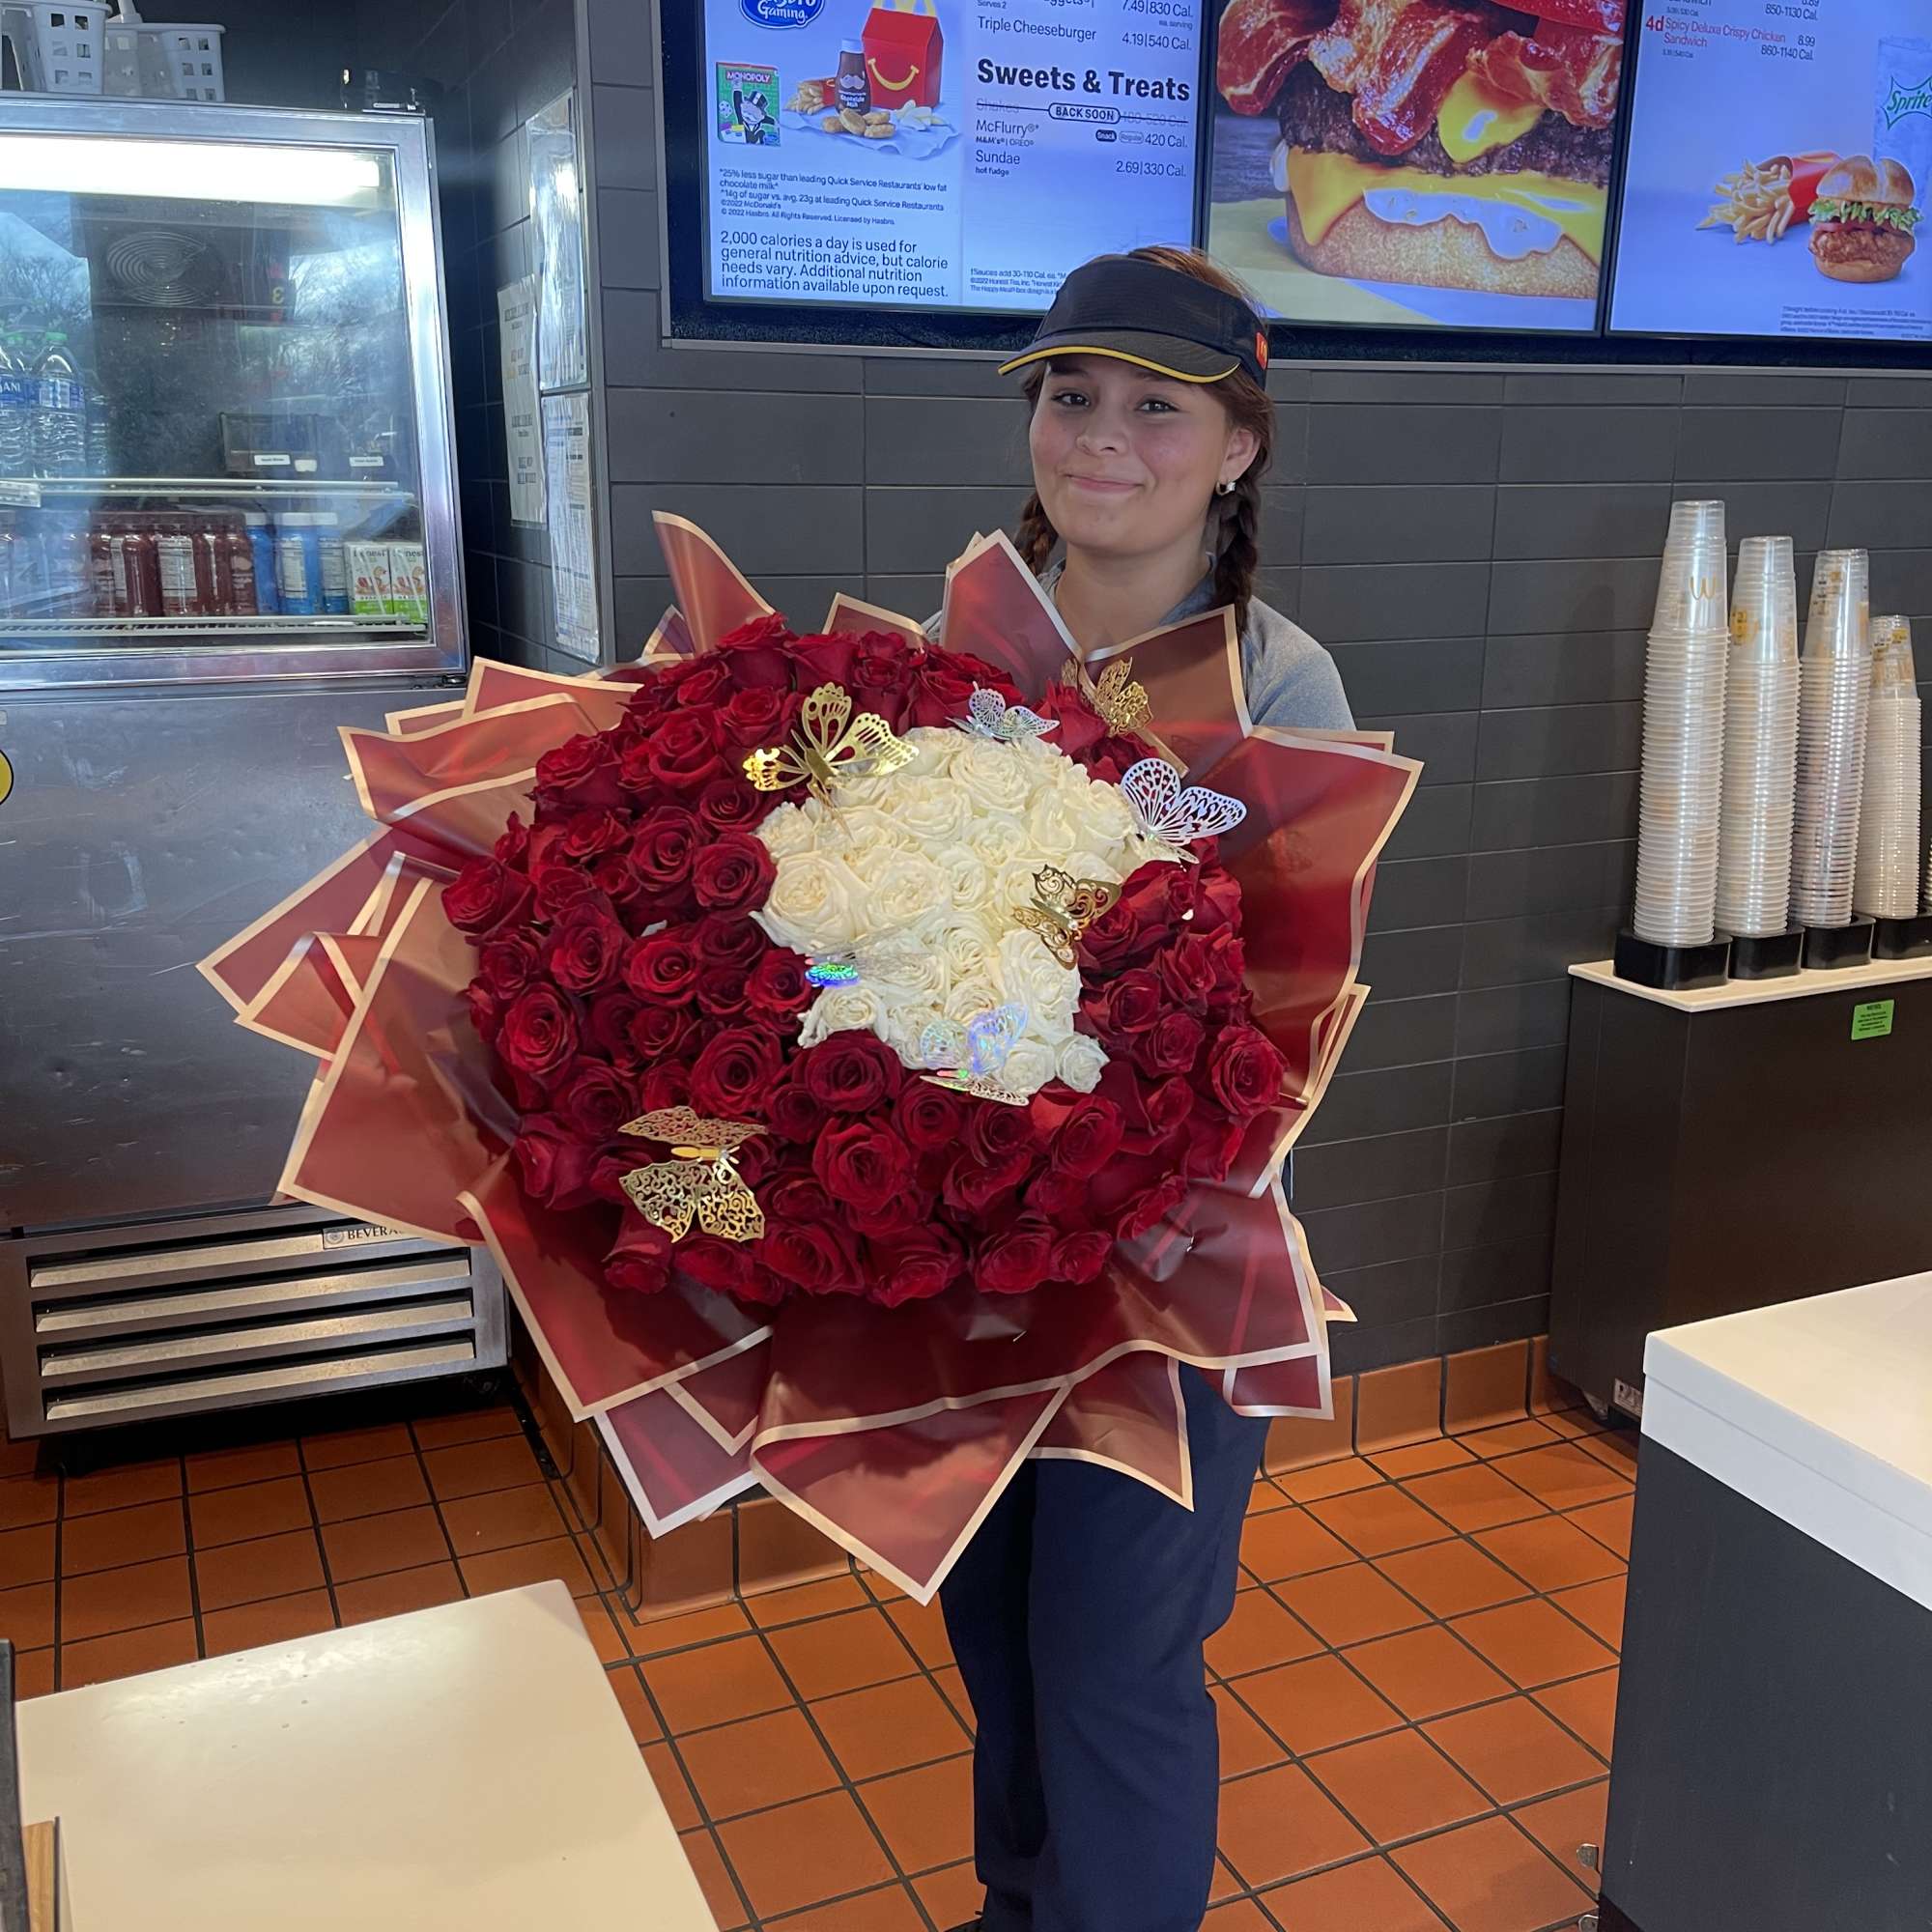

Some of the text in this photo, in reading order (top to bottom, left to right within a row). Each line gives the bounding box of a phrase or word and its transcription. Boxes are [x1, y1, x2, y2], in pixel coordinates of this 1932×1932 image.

[1173, 4, 1194, 17] Cal.
[977, 15, 1097, 43] Triple Cheeseburger
[1645, 15, 1664, 32] 4d
[1665, 17, 1690, 36] Spicy
[1691, 21, 1721, 35] Deluxe
[1722, 25, 1750, 42] Crispy
[1751, 28, 1786, 43] Chicken
[1664, 32, 1708, 46] Sandwich
[1172, 37, 1192, 50] Cal.
[727, 71, 771, 83] MONOPOLY
[978, 58, 1190, 101] Sweets & Treats
[1887, 90, 1932, 114] Sprite
[1055, 106, 1083, 118] BACK
[1084, 108, 1114, 121] SOON
[1145, 133, 1166, 146] 420
[1167, 134, 1188, 148] Cal.
[976, 149, 1020, 164] Sundae
[1166, 163, 1187, 177] Cal.
[988, 167, 1010, 177] fudge
[720, 179, 757, 189] chocolate
[742, 170, 756, 179] less
[757, 172, 779, 182] sugar
[781, 173, 799, 182] than
[799, 174, 826, 185] leading
[828, 176, 848, 185] Quick
[849, 178, 877, 187] Service
[923, 183, 936, 191] low
[937, 184, 948, 192] fat
[749, 192, 770, 201] sugar
[799, 194, 813, 205] 23g
[823, 196, 850, 207] leading
[851, 197, 871, 207] Quick
[873, 199, 901, 209] Service
[901, 201, 945, 212] Restaurants
[863, 216, 870, 225] by
[720, 231, 917, 253] 2,000 calories a day is used for
[721, 247, 949, 270] general nutrition advice, but calorie
[722, 261, 923, 282] needs vary. Additional nutrition
[722, 274, 949, 299] information available upon request.
